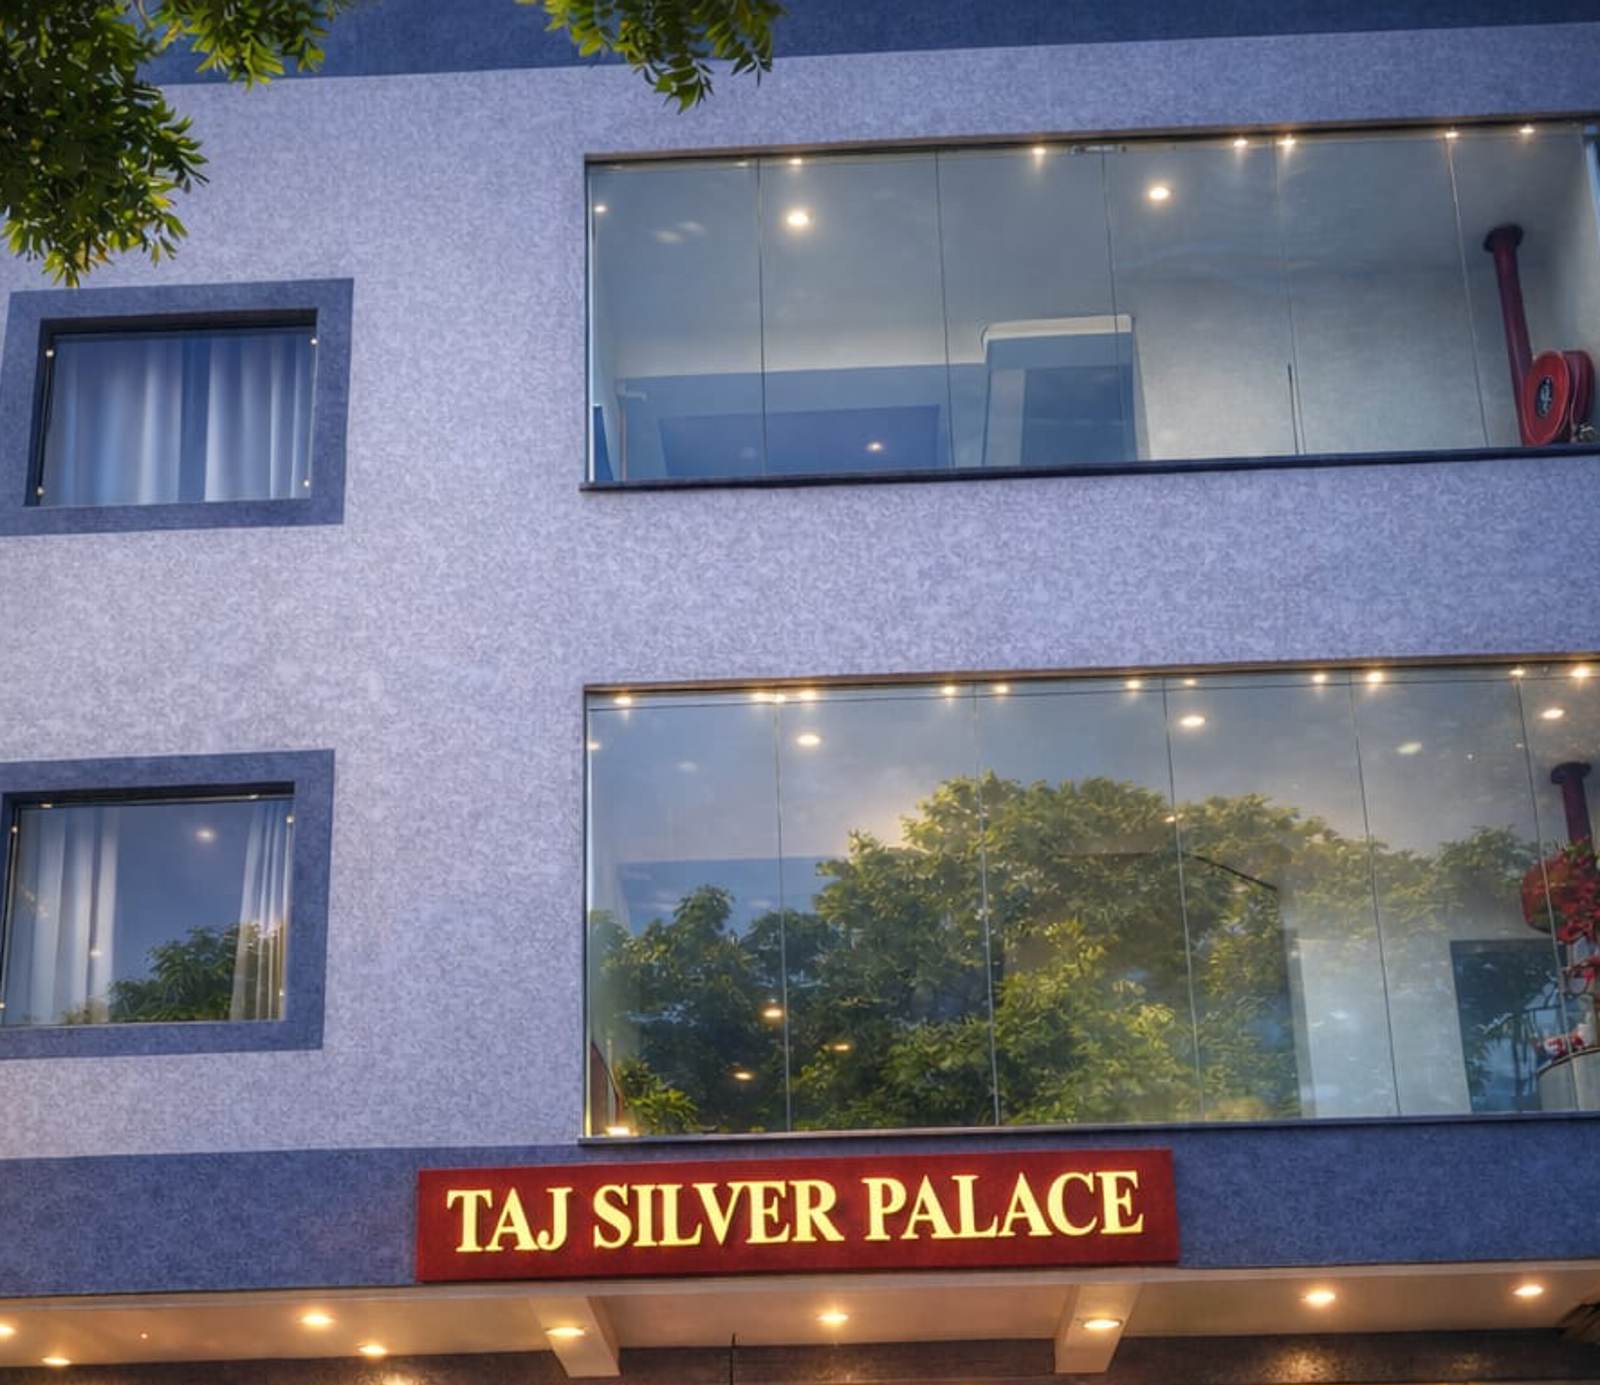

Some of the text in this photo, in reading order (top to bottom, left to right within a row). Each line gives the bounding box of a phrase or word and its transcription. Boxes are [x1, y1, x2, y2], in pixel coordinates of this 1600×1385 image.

[446, 1170, 1145, 1253] TAJ SILVER PALACE
